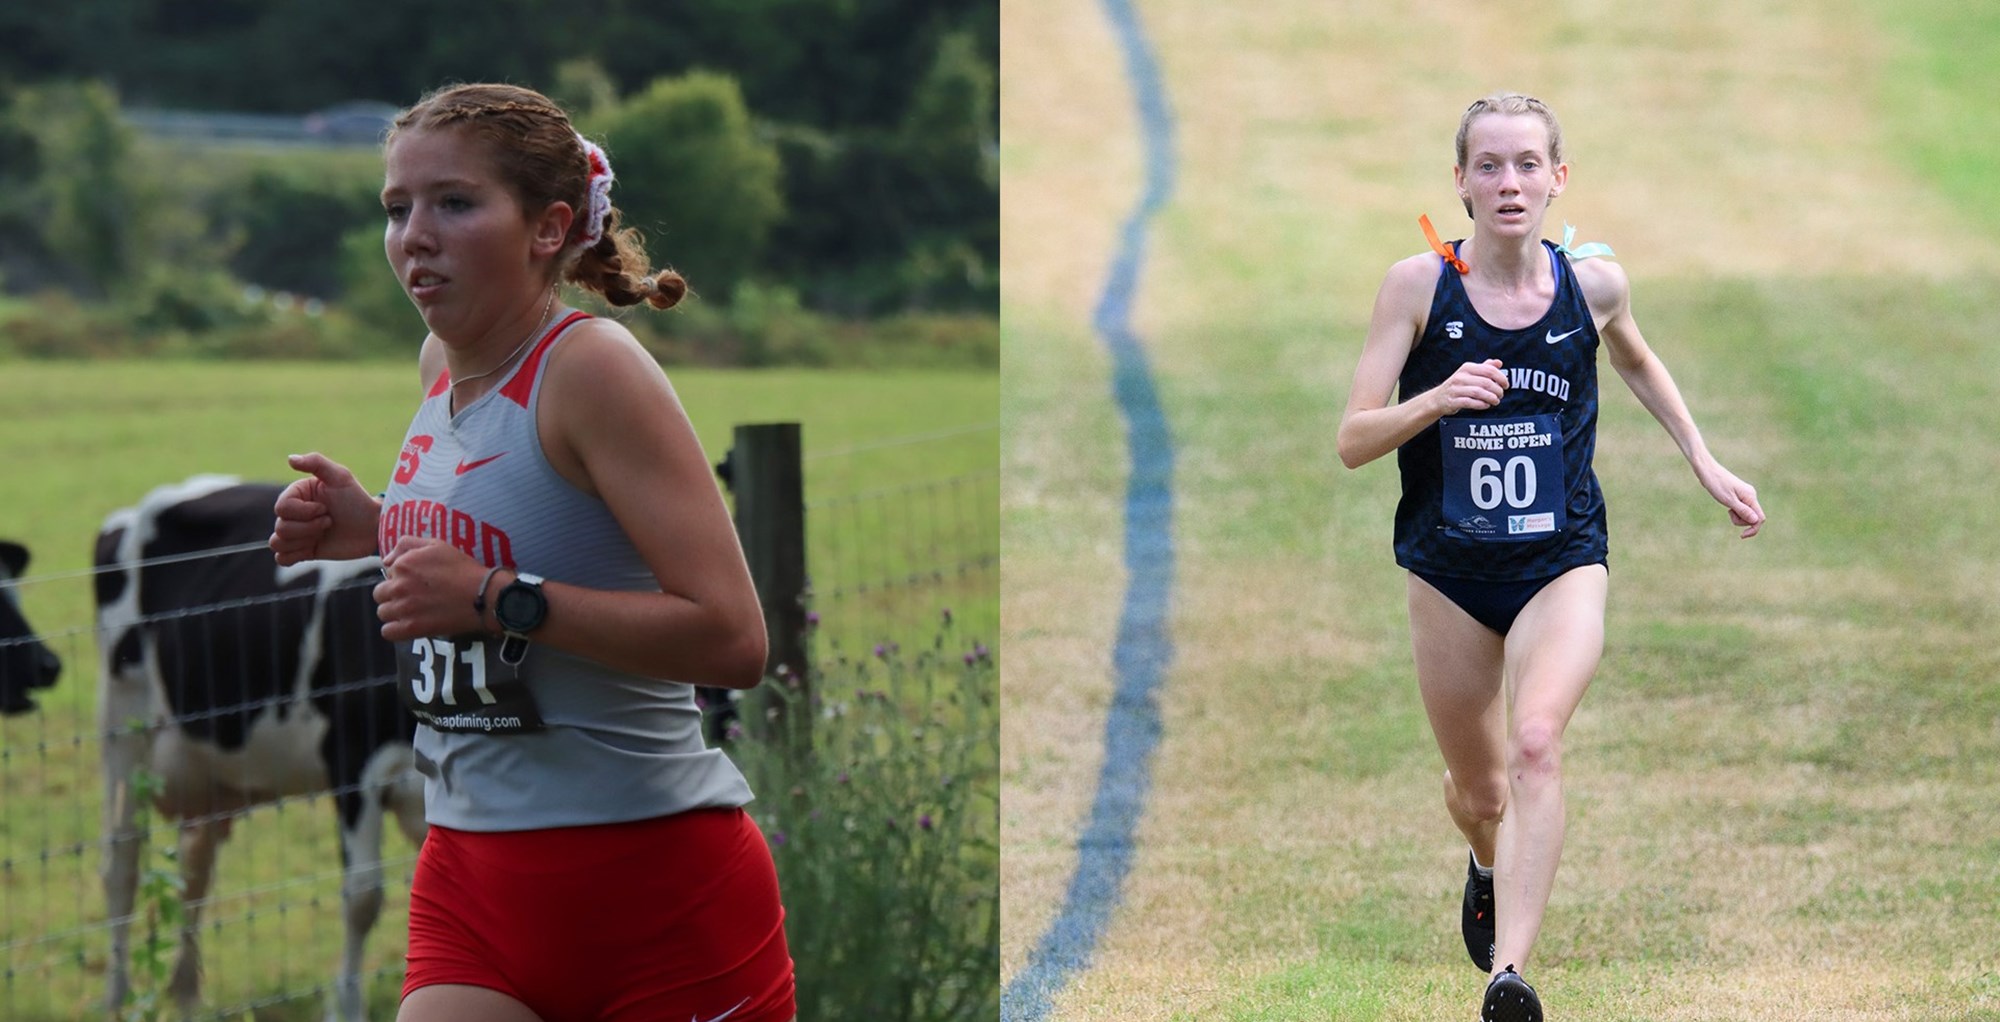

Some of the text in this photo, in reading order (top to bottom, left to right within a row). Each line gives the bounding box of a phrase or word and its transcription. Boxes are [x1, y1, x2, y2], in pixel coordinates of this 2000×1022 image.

[1454, 433, 1552, 450] HOME OPEN
[1469, 421, 1535, 437] LANCER
[1470, 455, 1537, 510] 60
[378, 499, 517, 570] ADFORD
[411, 637, 497, 705] 371
